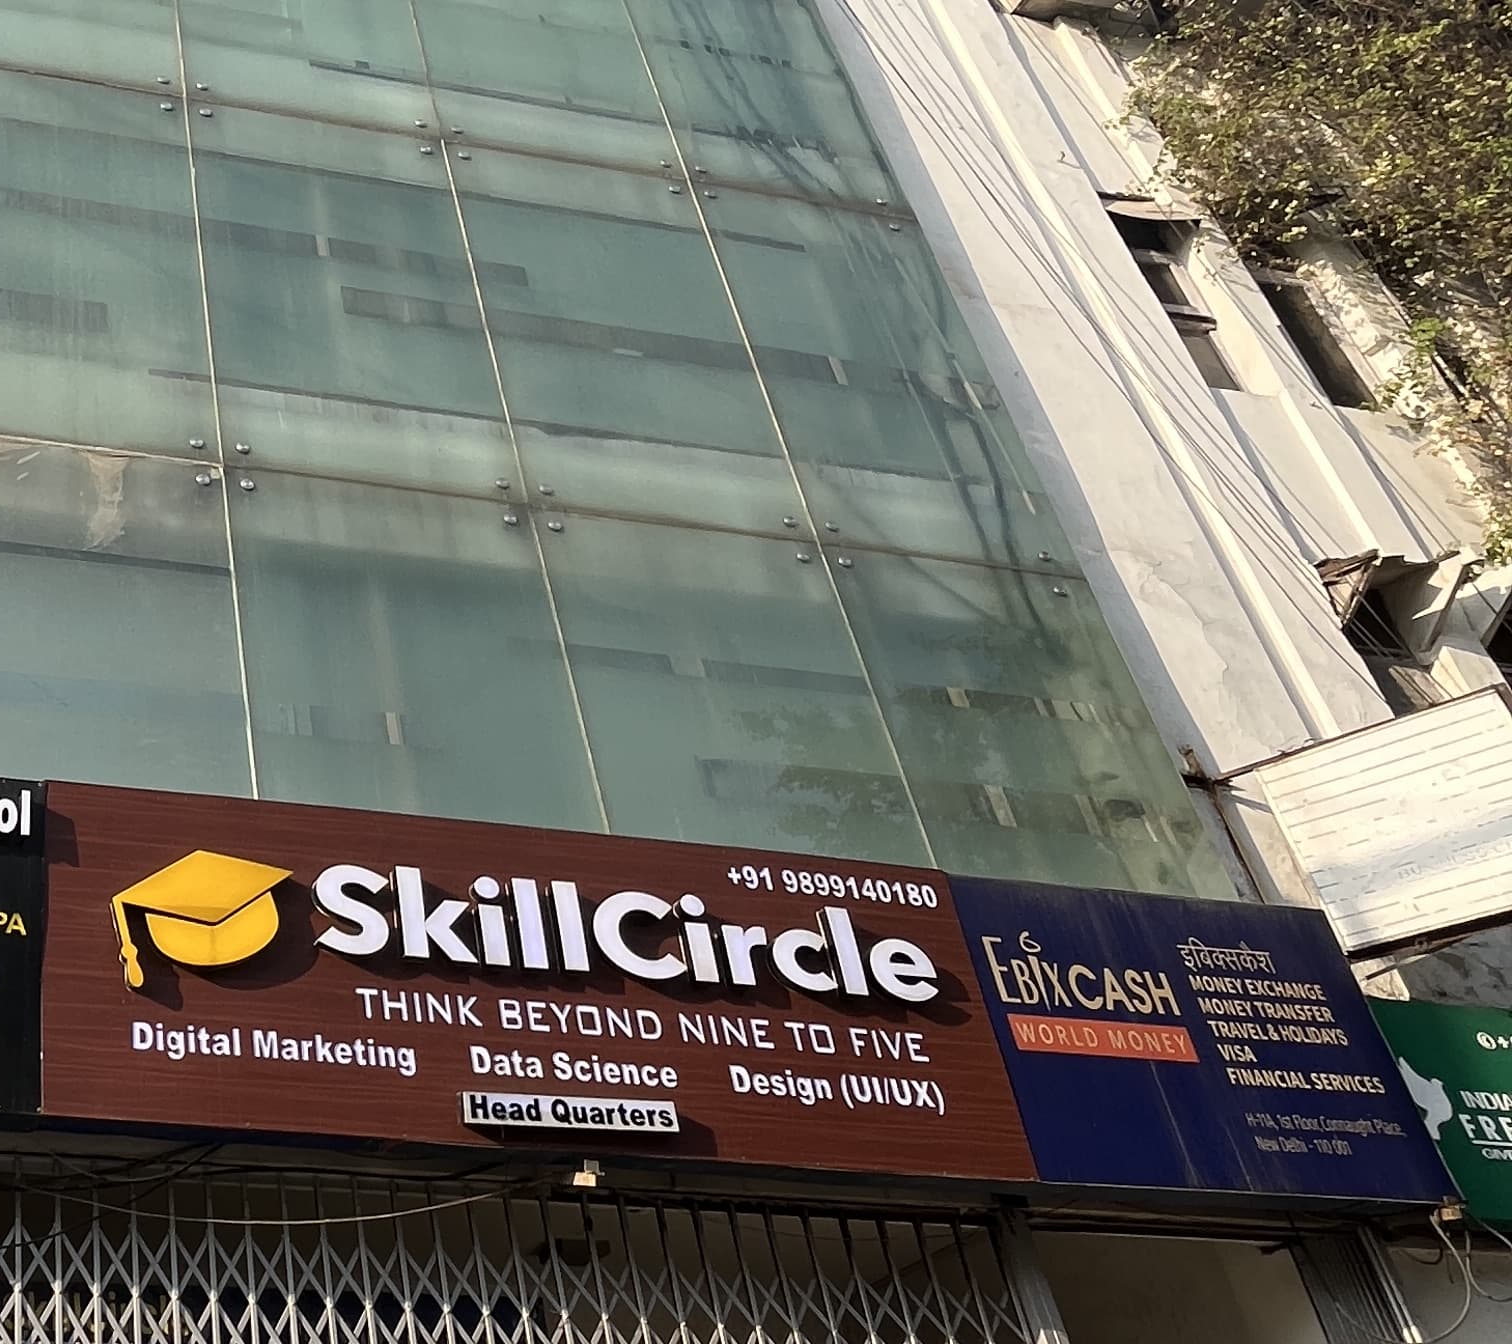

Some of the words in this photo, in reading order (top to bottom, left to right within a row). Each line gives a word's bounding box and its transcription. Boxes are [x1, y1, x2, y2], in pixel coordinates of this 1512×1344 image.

[728, 866, 773, 891] +91
[782, 869, 938, 908] 9899140180
[314, 864, 939, 1002] SkillCircle
[1188, 974, 1245, 995] MONEY
[1246, 978, 1327, 1001] EXCHANGE
[355, 987, 482, 1027] THINK
[498, 998, 662, 1041] BEYOND
[679, 1011, 775, 1049] NINE
[785, 1021, 836, 1055] TO
[850, 1027, 930, 1063] FIVE
[1197, 997, 1254, 1017] MONEY
[1254, 1001, 1335, 1023] TRANSFER
[132, 1021, 241, 1060] Digital
[253, 1029, 417, 1077] Marketing
[1016, 1021, 1098, 1048] WORLD
[1107, 1029, 1187, 1055] MONEY
[1207, 1020, 1269, 1040] TRAVEL
[1268, 1023, 1281, 1041] &
[1281, 1026, 1349, 1046] HOLIDAYS
[469, 1046, 544, 1079] Data
[554, 1051, 678, 1088] Science
[1217, 1044, 1257, 1063] VISA
[728, 1064, 832, 1106] Design
[841, 1074, 945, 1115] (UI/UX)
[1226, 1067, 1311, 1089] FINANCIAL
[1311, 1072, 1386, 1094] SERVICES
[469, 1094, 542, 1124] Head
[551, 1099, 674, 1128] Quarters
